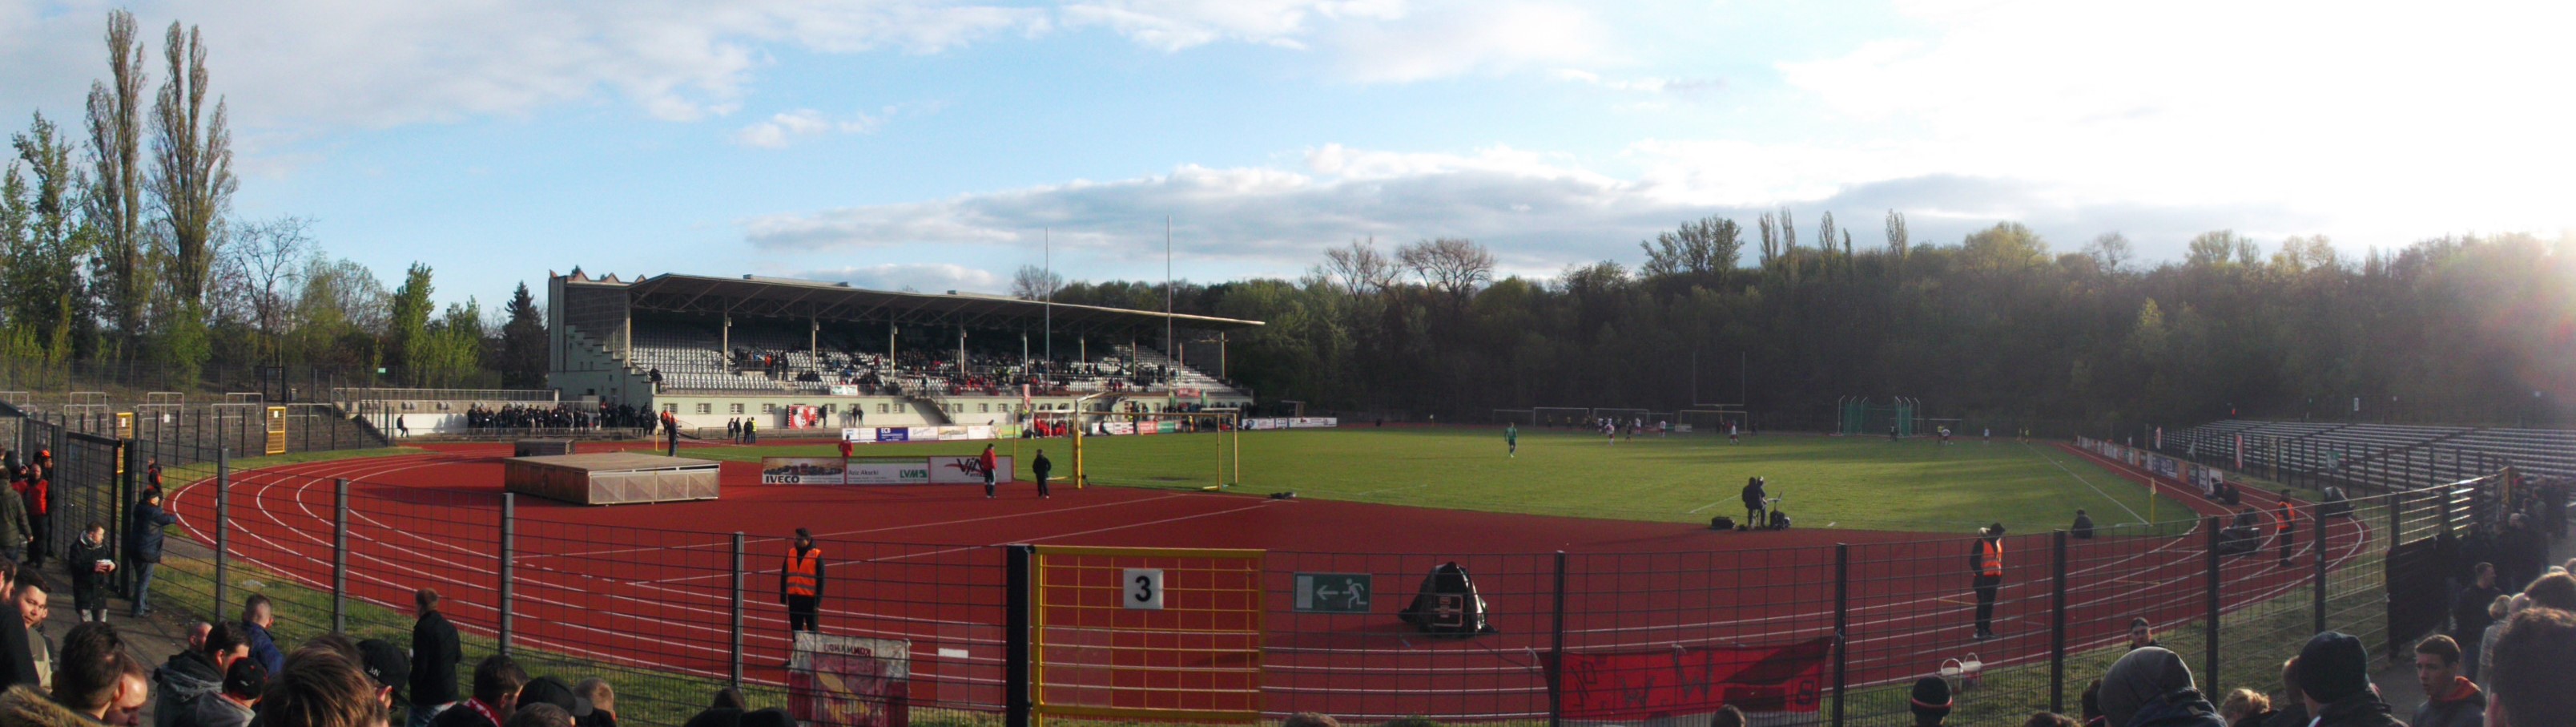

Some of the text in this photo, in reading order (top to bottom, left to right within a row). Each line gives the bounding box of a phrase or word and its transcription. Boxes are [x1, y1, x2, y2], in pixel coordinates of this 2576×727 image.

[766, 475, 800, 483] IVECO
[900, 469, 919, 479] LVM
[1135, 576, 1152, 602] 3
